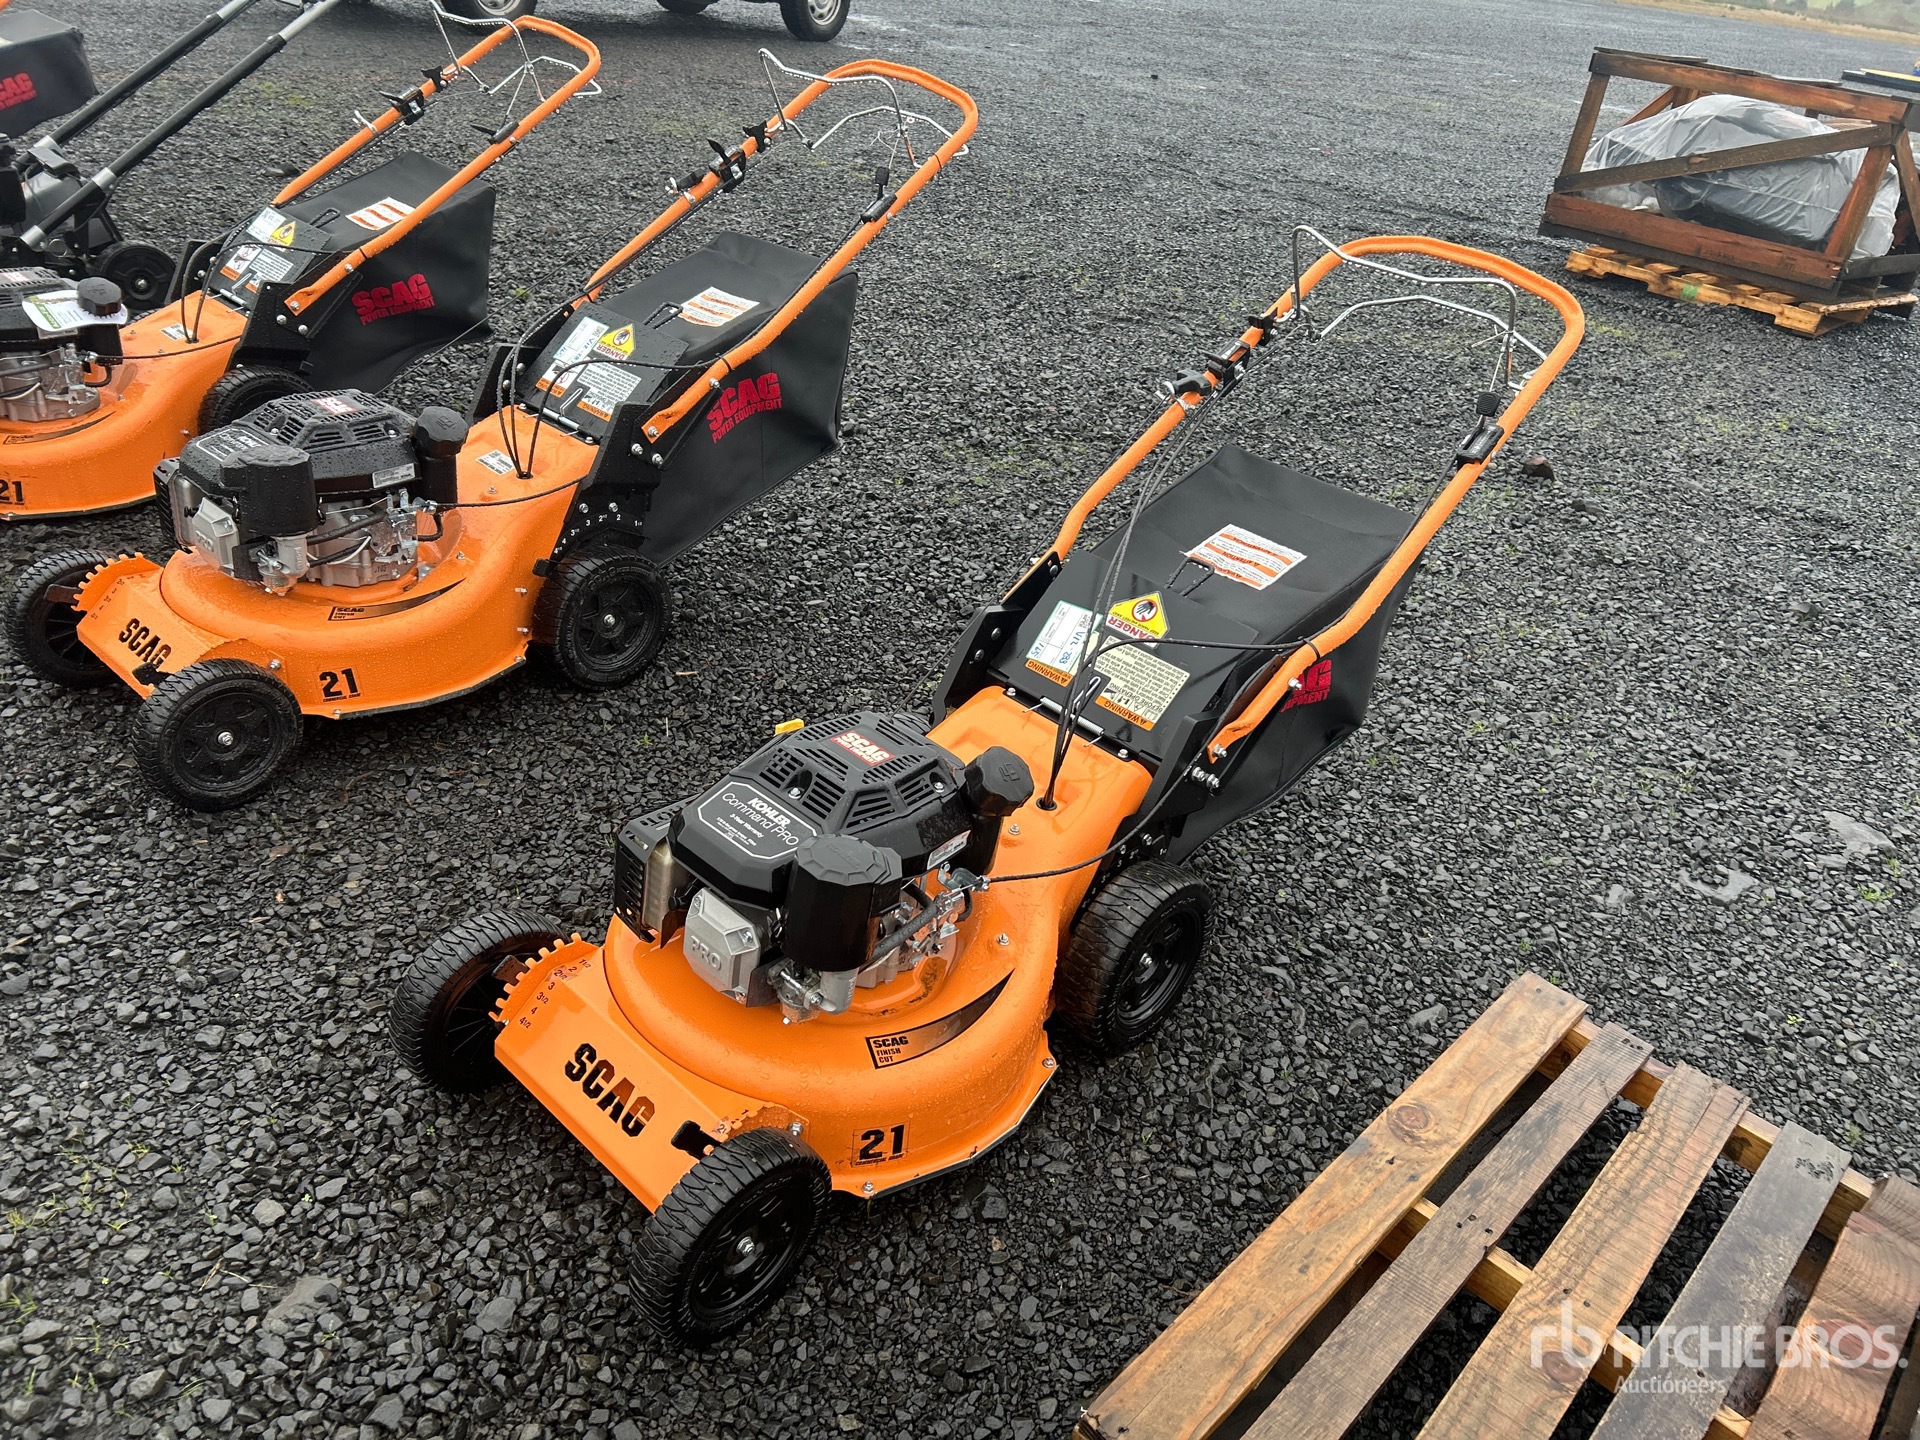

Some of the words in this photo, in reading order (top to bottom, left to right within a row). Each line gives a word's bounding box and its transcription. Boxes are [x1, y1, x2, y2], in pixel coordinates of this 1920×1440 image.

[351, 273, 431, 315] SCAG
[596, 343, 625, 360] DANGER
[706, 372, 781, 430] SCAG
[712, 417, 735, 443] POWER
[734, 397, 782, 424] EQUIPMENT
[118, 618, 172, 669] SCAG
[318, 668, 359, 698] 21
[1027, 660, 1061, 682] WARNING
[1107, 682, 1141, 701] OPERATING
[1139, 698, 1163, 712] BEFORE
[1103, 700, 1139, 724] WARNING
[841, 732, 890, 761] SCAG
[722, 793, 775, 830] Command
[771, 825, 799, 846] PRO
[747, 797, 791, 828] KOHLER
[691, 935, 722, 970] PRO
[548, 982, 555, 990] 3
[531, 1007, 538, 1015] 4
[872, 1036, 909, 1048] SCAG
[876, 1048, 902, 1057] FINISH
[878, 1055, 894, 1063] CUT
[564, 1042, 655, 1138] SCAG
[859, 1124, 905, 1160] 21
